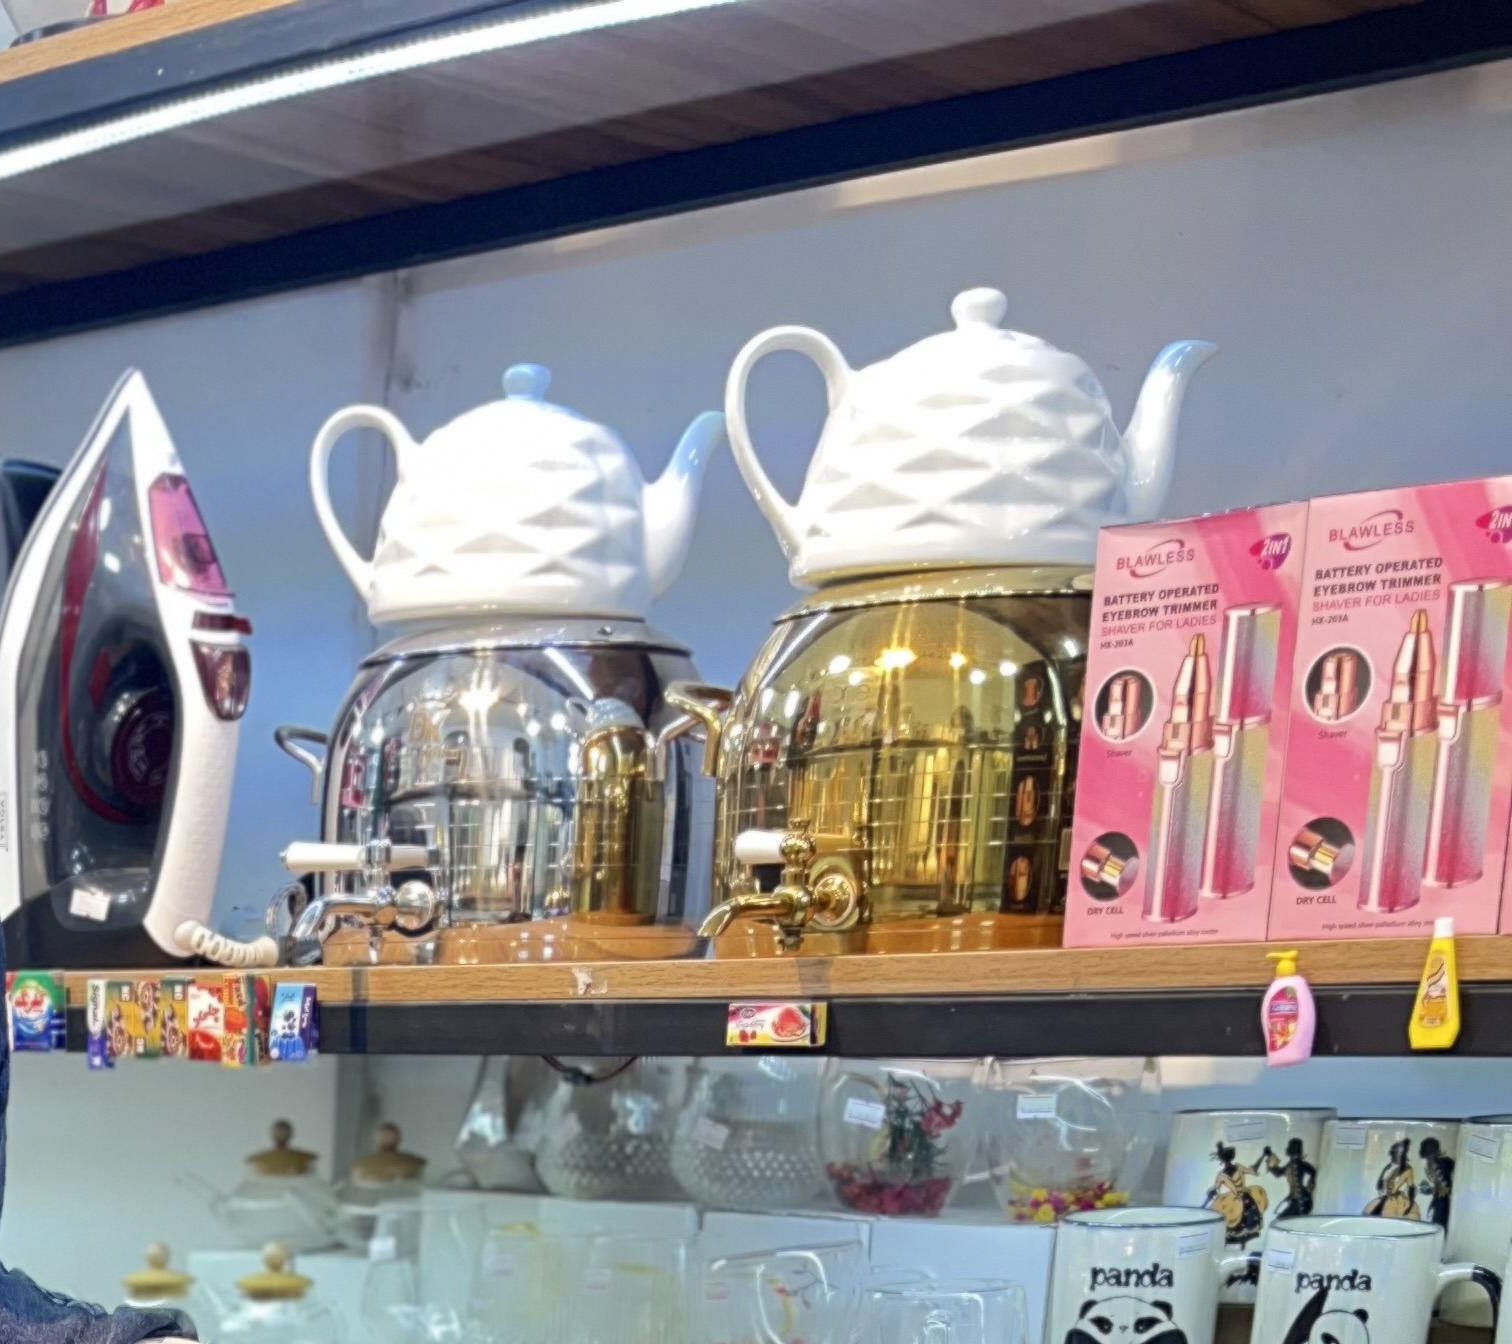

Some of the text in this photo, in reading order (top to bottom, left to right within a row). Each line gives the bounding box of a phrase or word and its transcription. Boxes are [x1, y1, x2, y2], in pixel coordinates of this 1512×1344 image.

[1329, 521, 1415, 542] BLAWLESS
[1489, 511, 1512, 529] 2IN
[1263, 535, 1289, 556] 2IN1
[1117, 549, 1195, 570] BLAWLESS
[1315, 557, 1443, 580] BATTERY OPERATED
[1104, 583, 1219, 607] BATTERY OPERATED
[1314, 573, 1441, 597] EYEBROW TRIMMER
[1102, 599, 1217, 623] EYEBROW TRIMMER
[1312, 589, 1440, 612] SHAVER FOR LADIES
[1101, 614, 1217, 637] SHAVER FOR LADIES
[1296, 894, 1337, 906] DRY CELL
[1090, 1262, 1174, 1291] panda
[1295, 1268, 1372, 1294] panda
